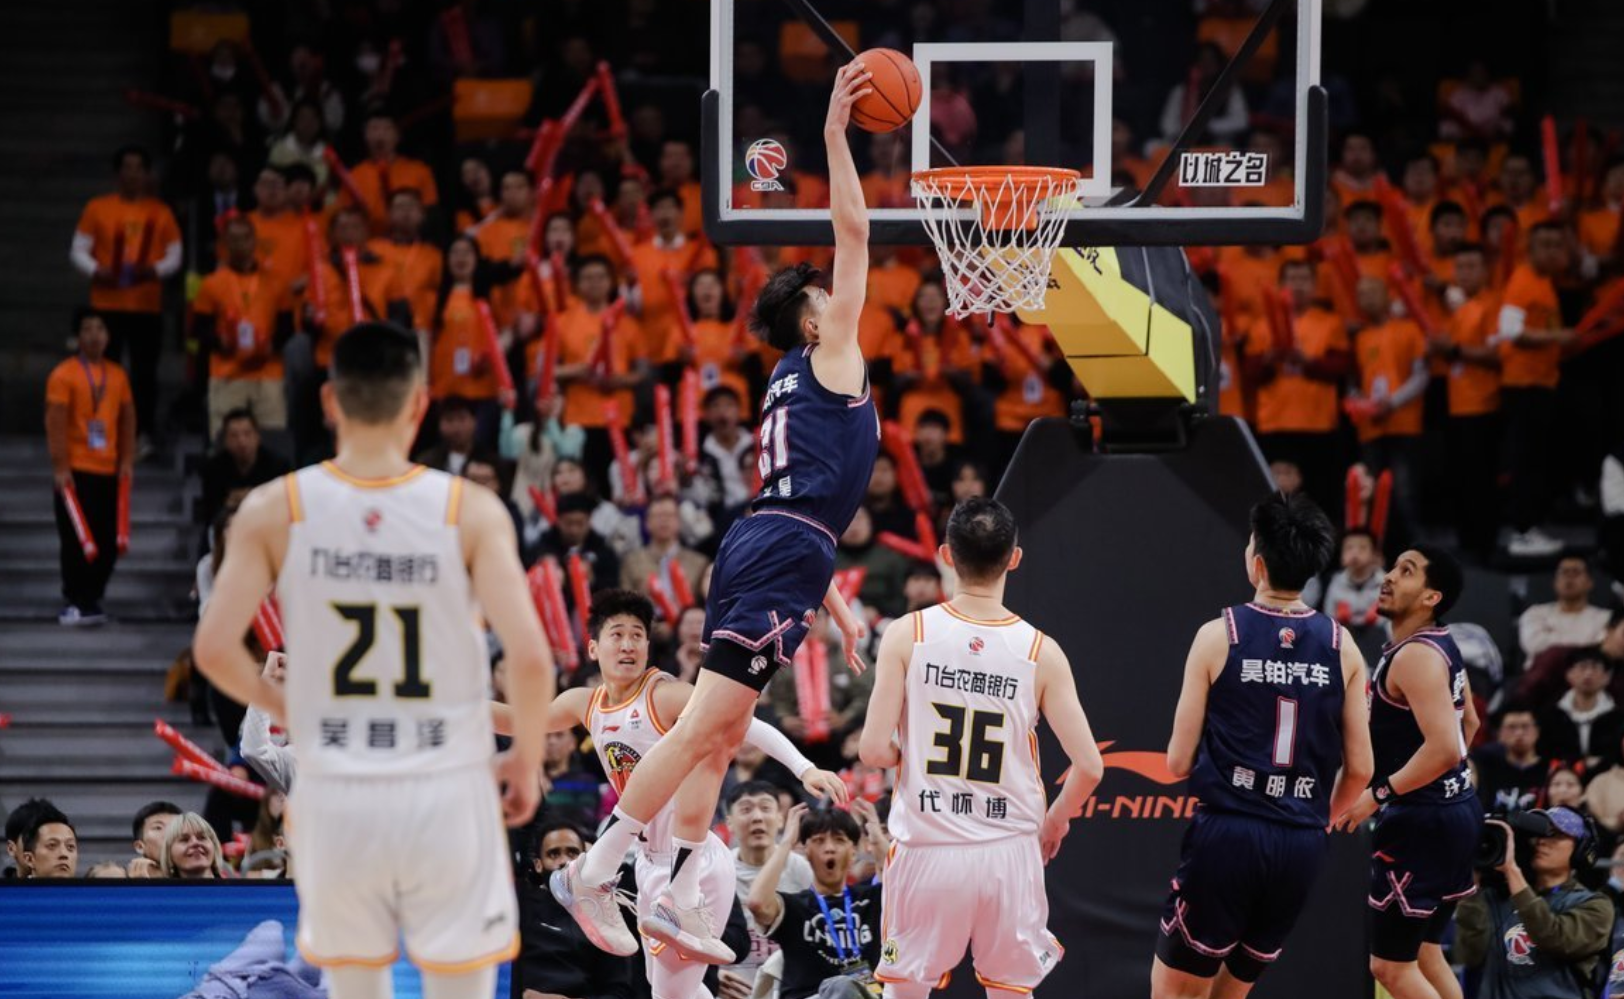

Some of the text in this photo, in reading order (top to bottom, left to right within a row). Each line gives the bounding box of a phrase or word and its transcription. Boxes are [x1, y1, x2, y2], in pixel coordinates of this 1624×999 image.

[1180, 153, 1266, 186] 以城之名
[328, 600, 434, 700] 21
[924, 662, 1019, 701] 九台农商银行
[1240, 658, 1331, 688] 昊铂汽车
[926, 701, 1005, 784] 36
[1272, 695, 1298, 768] 1
[1232, 766, 1315, 799] 黄明依
[919, 789, 1008, 820] 代怀博
